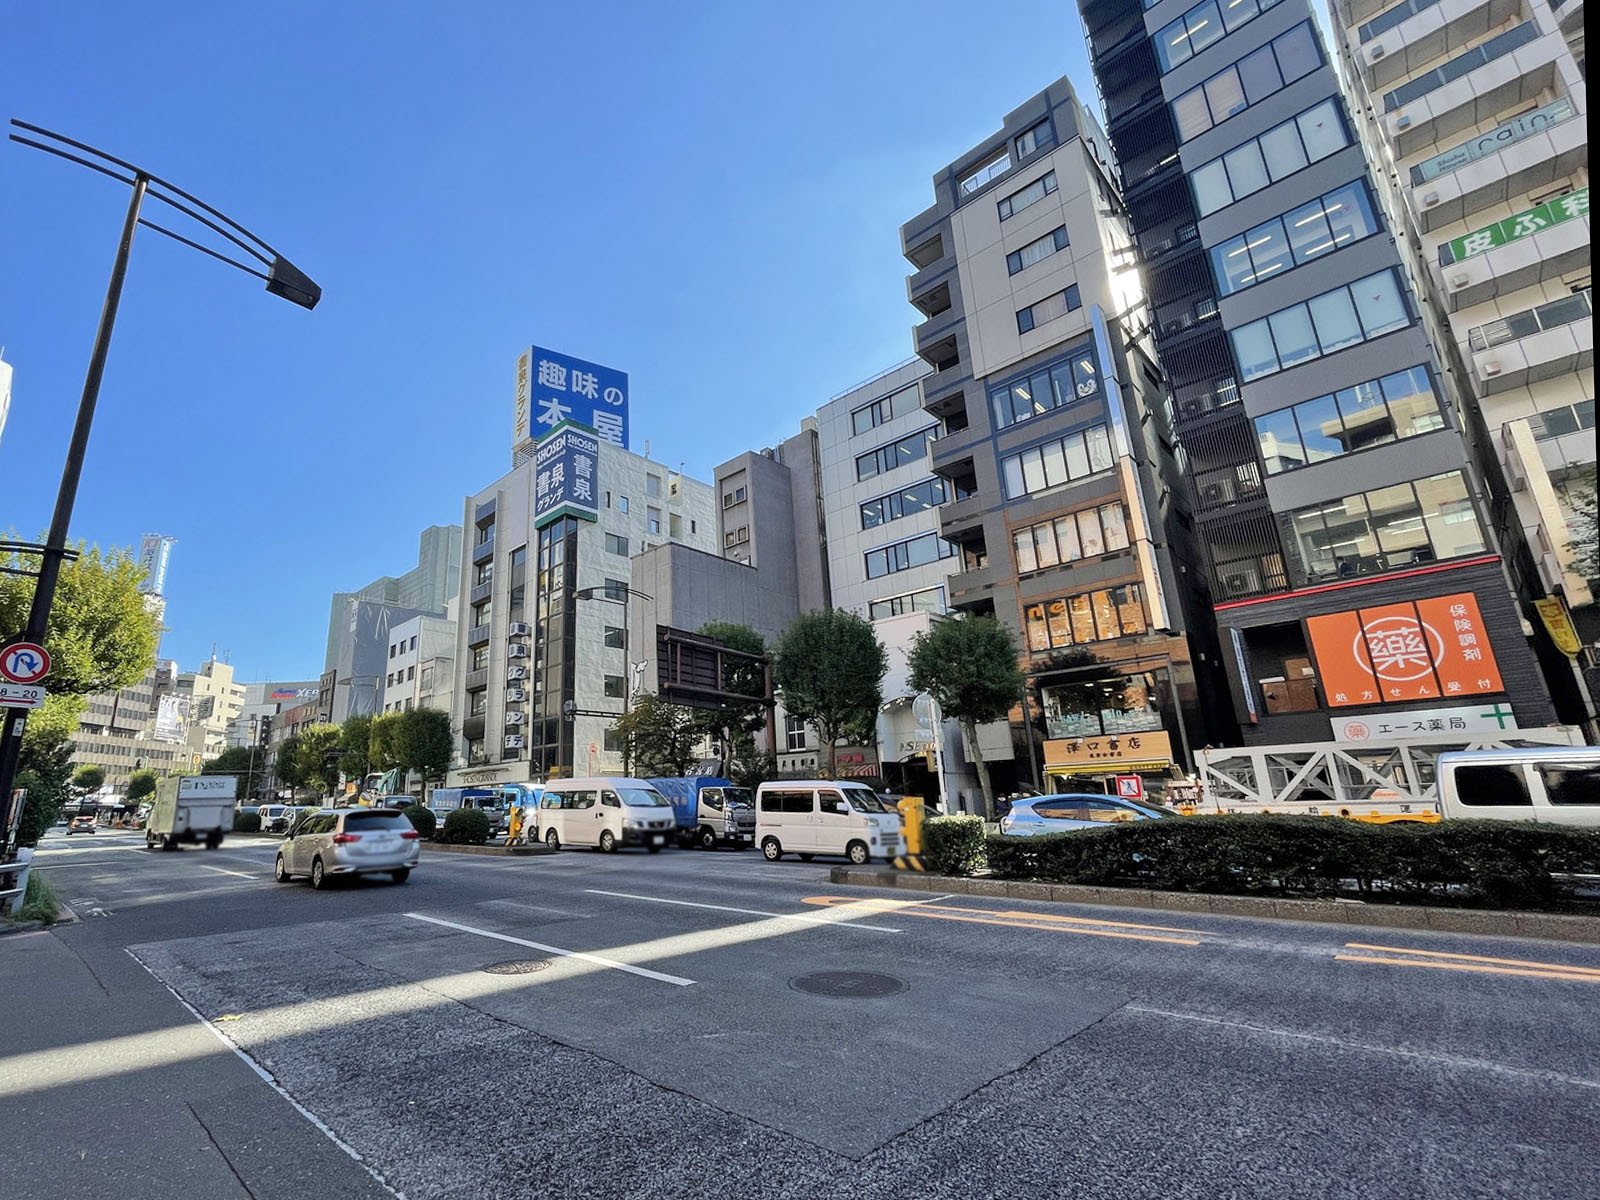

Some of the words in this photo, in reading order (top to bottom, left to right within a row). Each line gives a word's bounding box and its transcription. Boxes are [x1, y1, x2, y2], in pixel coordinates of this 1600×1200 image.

[538, 360, 624, 406] 趣味の
[537, 398, 625, 448] 本屋
[537, 435, 566, 464] SHOSEN
[567, 434, 597, 452] SHOSEN
[537, 462, 565, 498] 書泉
[573, 453, 593, 501] 書泉
[1449, 603, 1482, 662] 保険調剤
[1335, 678, 1492, 703] 処方せん受付
[1378, 716, 1467, 735] エース薬局
